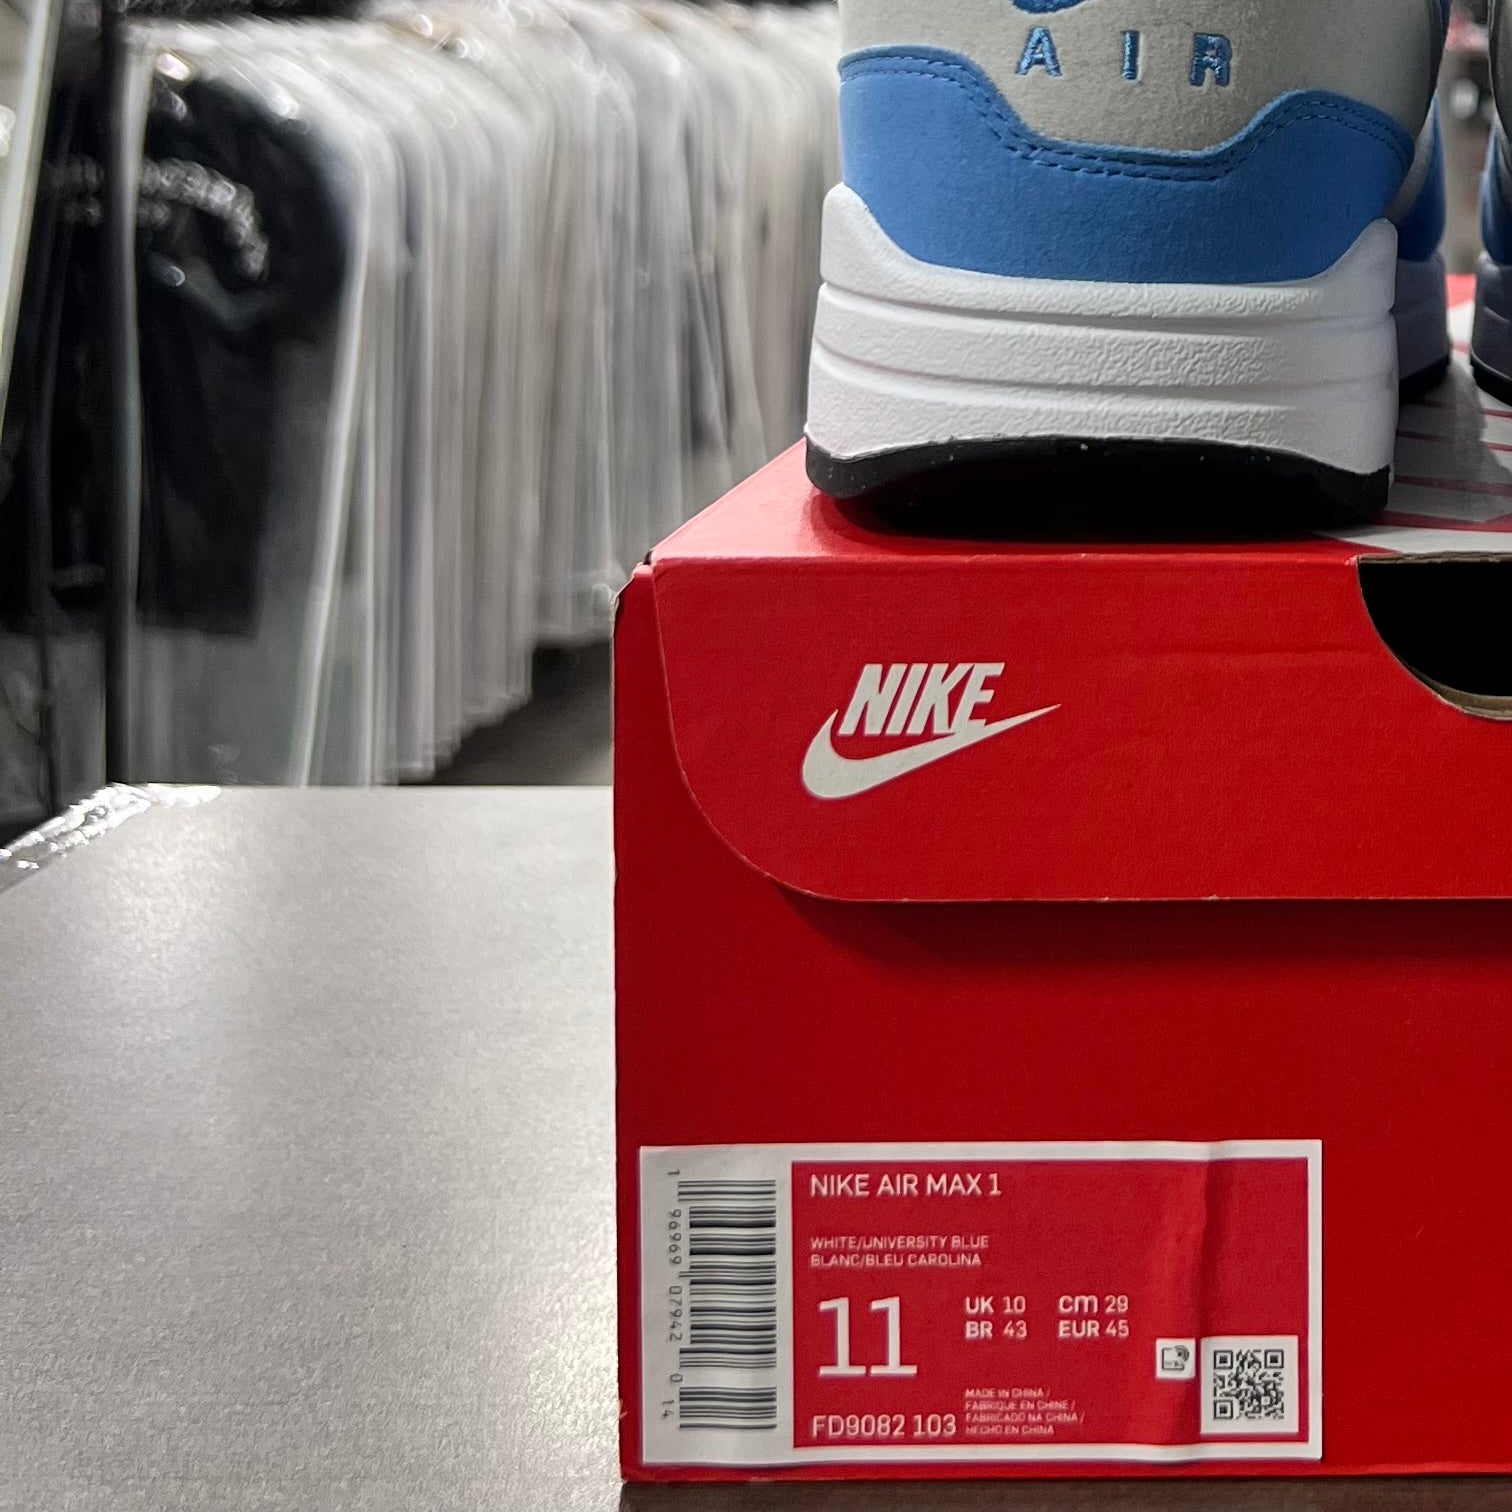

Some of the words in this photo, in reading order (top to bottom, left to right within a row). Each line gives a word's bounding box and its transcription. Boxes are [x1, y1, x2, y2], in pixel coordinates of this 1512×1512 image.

[1014, 26, 1234, 88] AIR
[837, 662, 1006, 737] NIKE
[810, 1173, 870, 1196] NIKE
[876, 1173, 919, 1196] AIR
[925, 1173, 982, 1196] MAX
[989, 1173, 1002, 1196] 1
[668, 1208, 682, 1266] 96969
[810, 1235, 948, 1250] WHITE/UNIVERSITY
[951, 1235, 990, 1249] BLUE
[810, 1253, 904, 1268] BLANC/BLEU
[907, 1253, 982, 1267] CAROLINA
[669, 1285, 684, 1343] 07942
[965, 1296, 994, 1314] UK
[1003, 1296, 1026, 1314] 10
[1104, 1295, 1129, 1313] 29
[819, 1296, 918, 1377] 11
[965, 1320, 993, 1338] BR
[1003, 1320, 1027, 1338] 43
[1058, 1320, 1100, 1338] EUR
[1105, 1319, 1129, 1337] 45
[965, 1388, 995, 1399] MADE
[998, 1388, 1009, 1398] IN
[1011, 1388, 1044, 1398] CHINA
[811, 1414, 905, 1437] FD9082
[913, 1414, 956, 1436] 103
